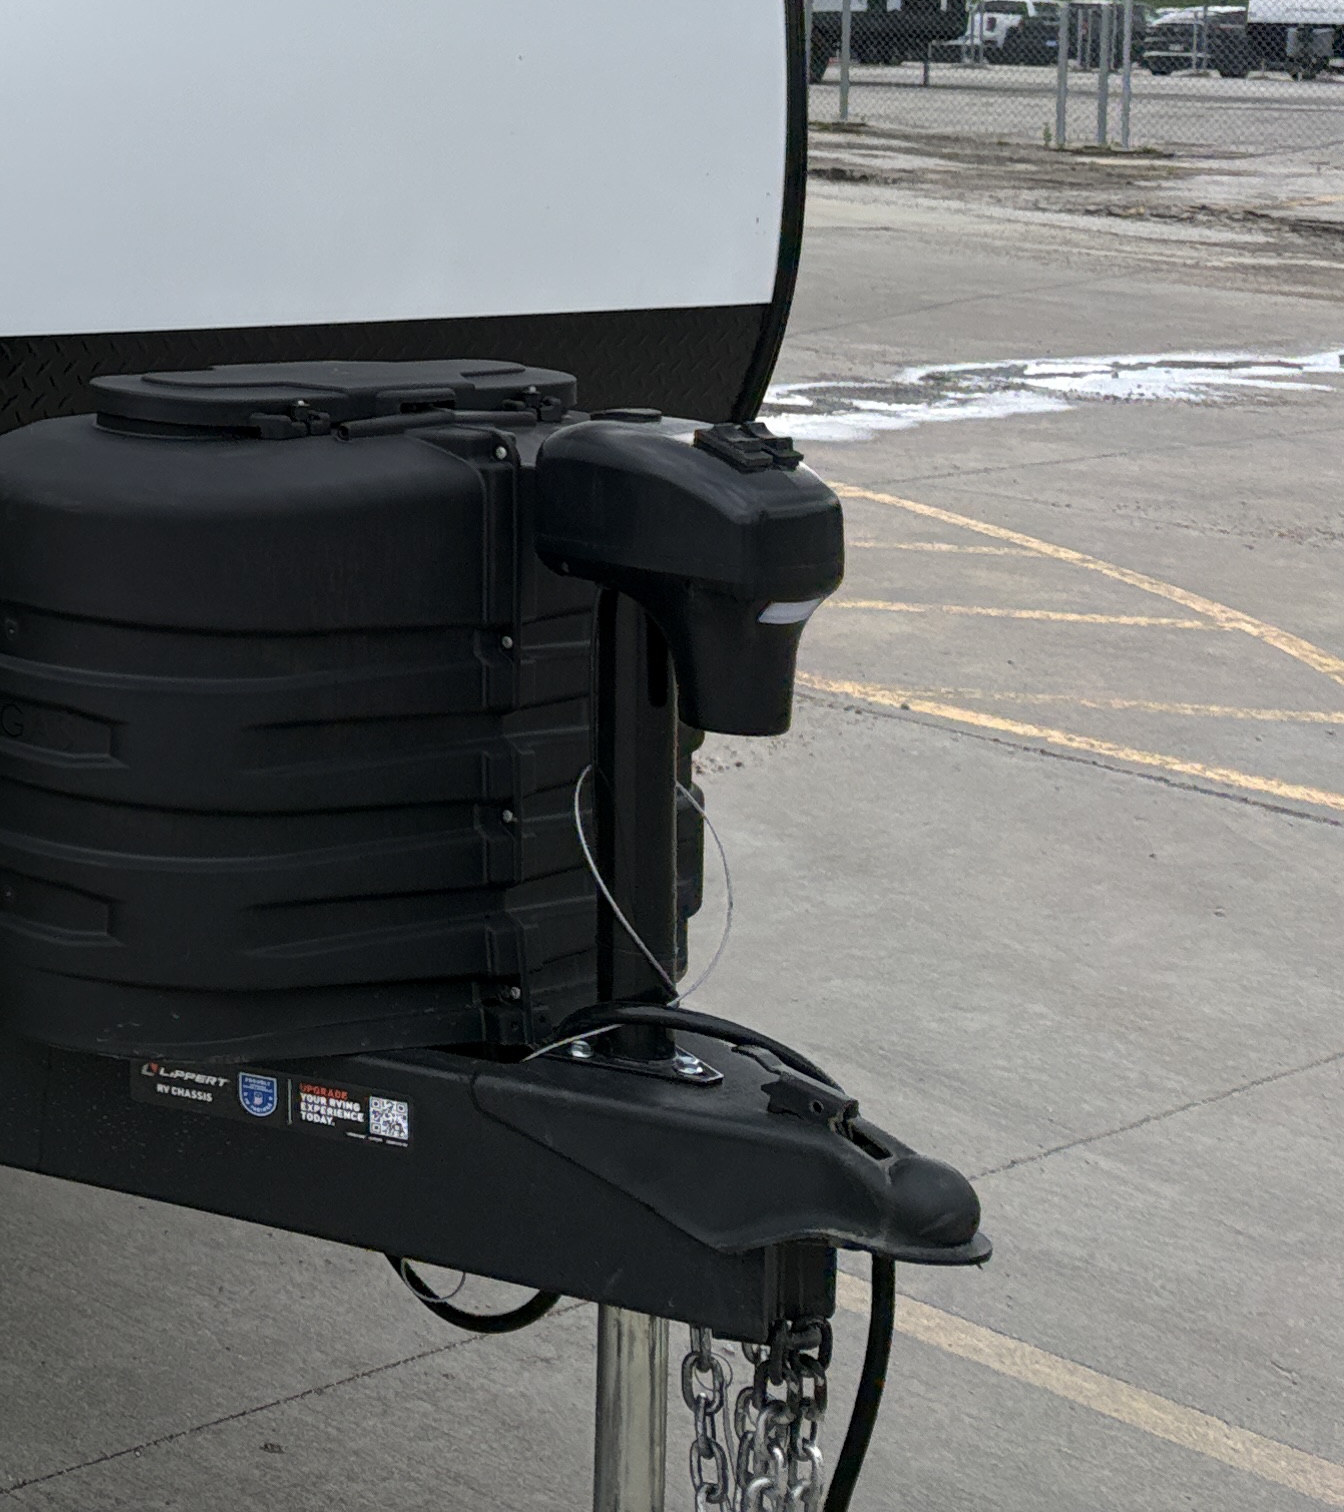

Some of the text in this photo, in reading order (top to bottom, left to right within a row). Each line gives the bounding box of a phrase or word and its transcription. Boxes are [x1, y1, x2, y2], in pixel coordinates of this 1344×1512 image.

[159, 1067, 231, 1087] LIPPERT
[156, 1083, 214, 1103] RV CHASSIS
[299, 1083, 349, 1100] UPGRADE
[300, 1092, 361, 1112] YOUR RVING
[300, 1101, 365, 1123] EXPERIENCE
[300, 1111, 336, 1126] TODAY.
